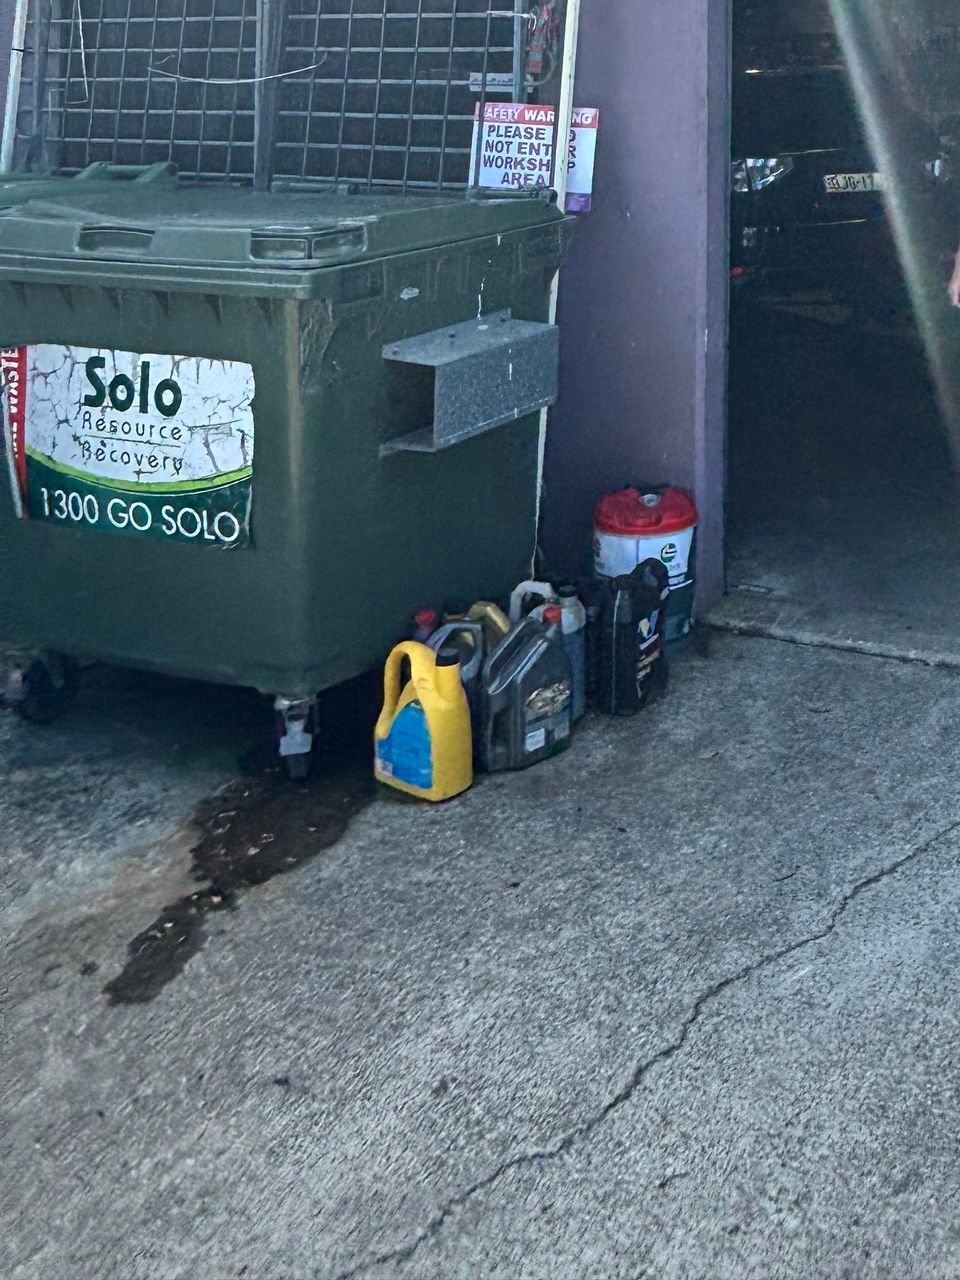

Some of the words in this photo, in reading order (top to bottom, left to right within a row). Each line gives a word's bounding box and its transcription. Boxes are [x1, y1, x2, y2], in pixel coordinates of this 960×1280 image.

[484, 107, 521, 122] AFETY
[524, 108, 593, 124] WARNG
[487, 124, 546, 141] PLEASE
[485, 140, 514, 155] NOT
[517, 142, 577, 159] ENTR
[484, 154, 576, 174] WORKSHP
[501, 171, 546, 187] AREA
[82, 356, 183, 417] Solo
[82, 410, 183, 441] Resource
[81, 439, 184, 475] Recovery
[40, 487, 99, 524] 1300
[107, 497, 152, 531] GO
[161, 504, 240, 542] SOLO
